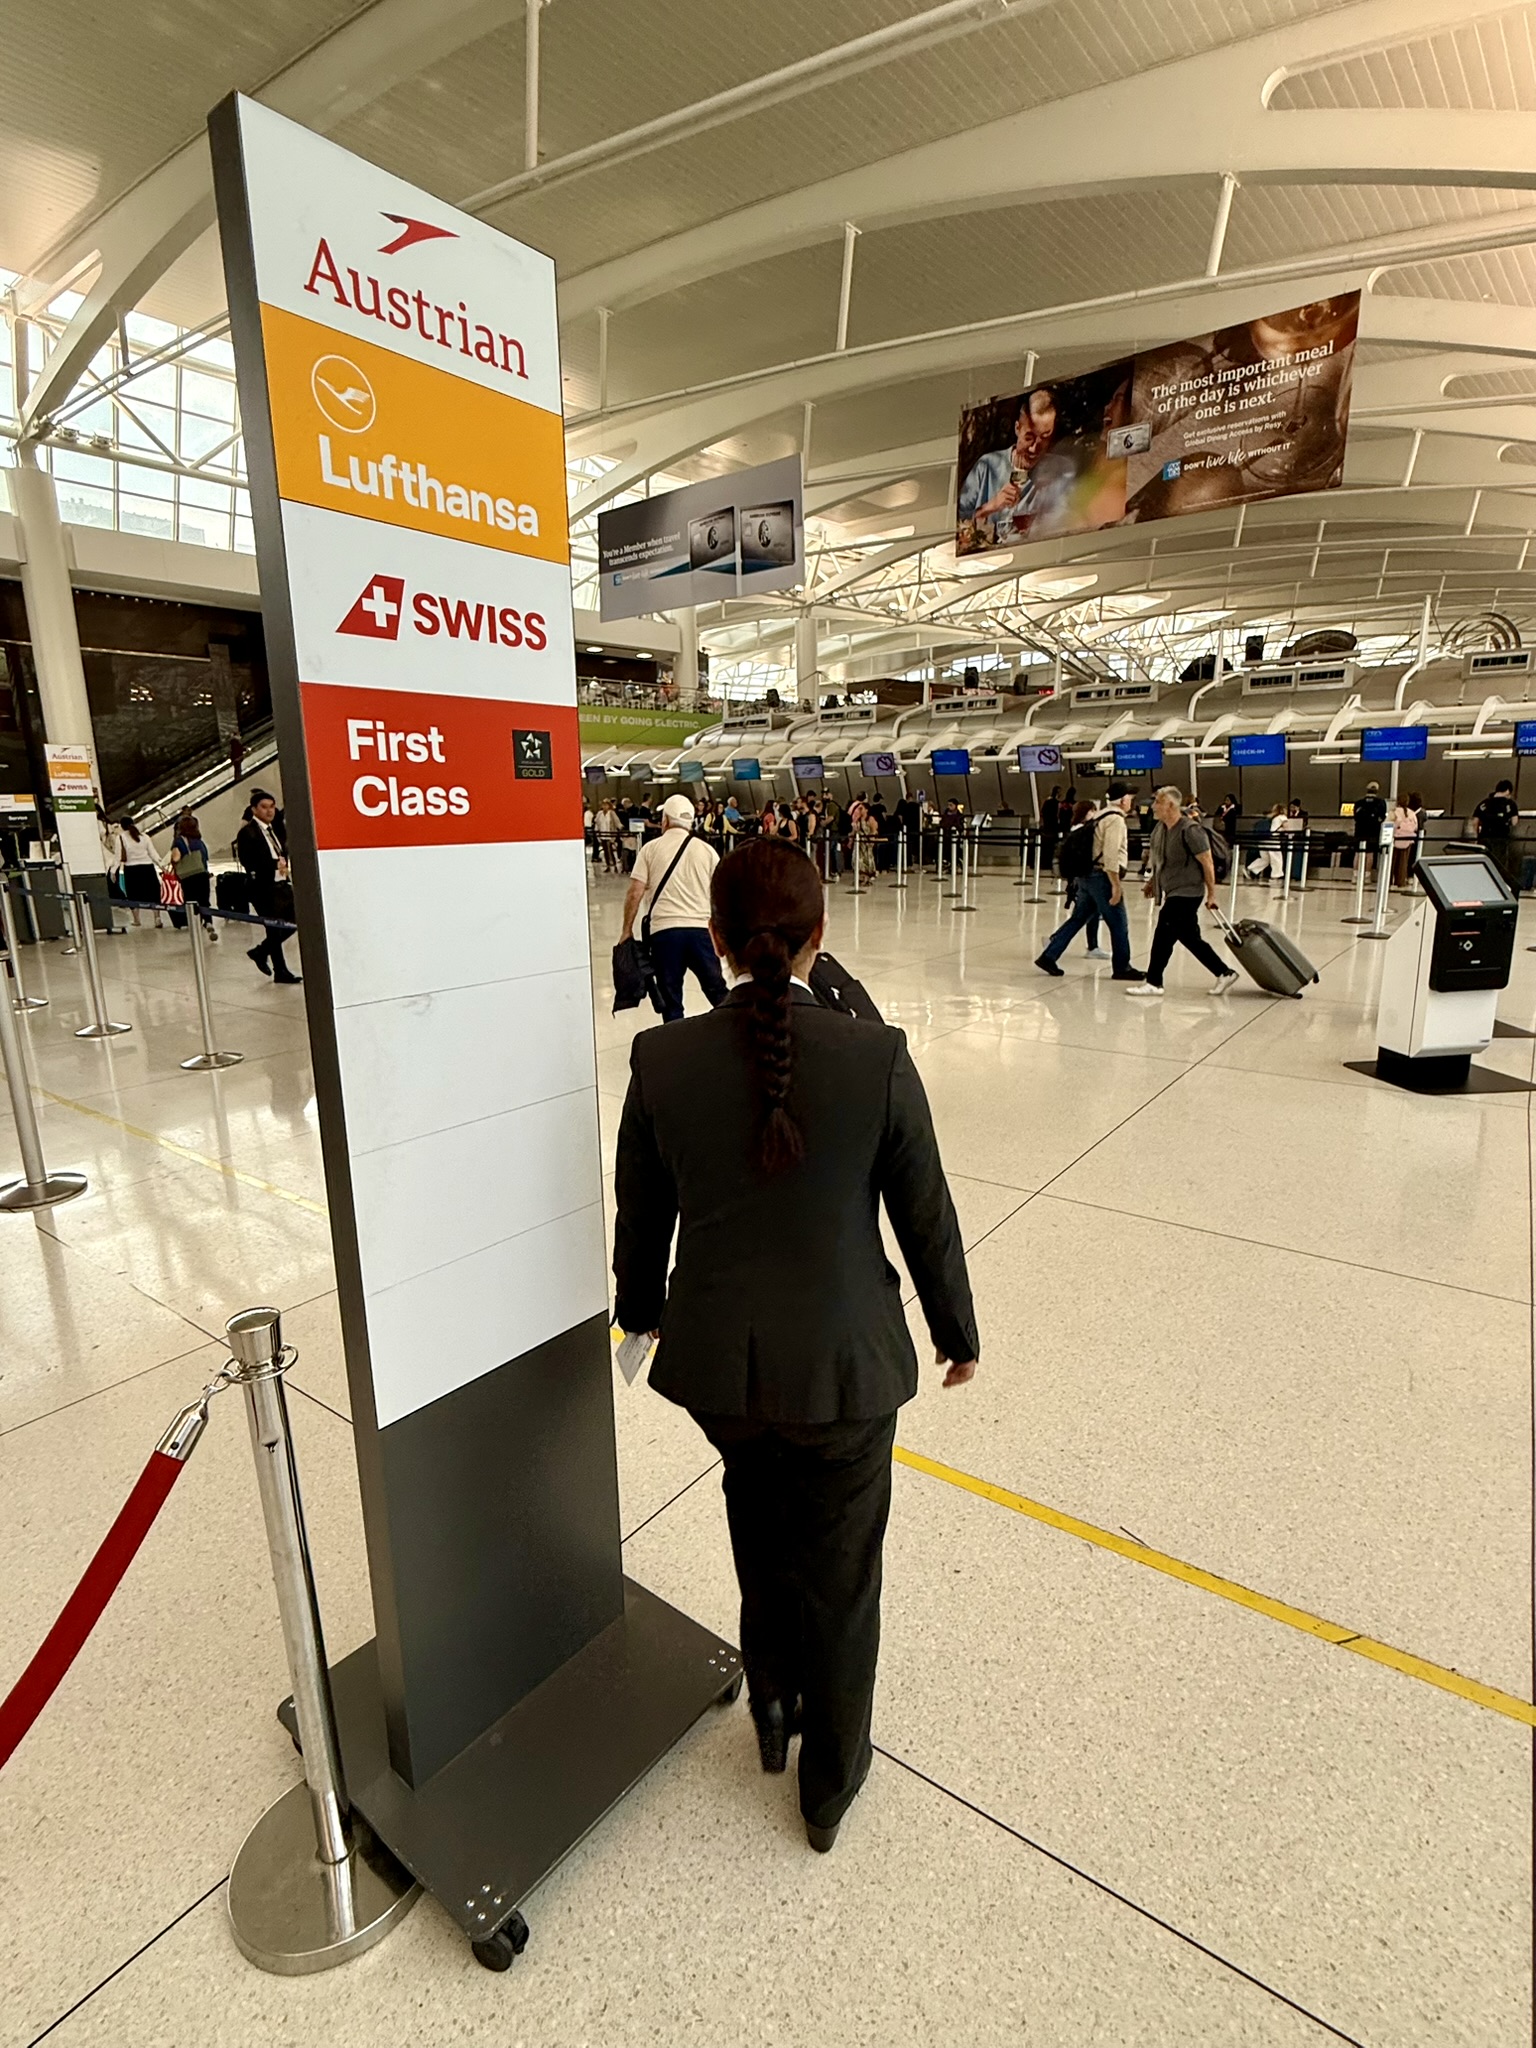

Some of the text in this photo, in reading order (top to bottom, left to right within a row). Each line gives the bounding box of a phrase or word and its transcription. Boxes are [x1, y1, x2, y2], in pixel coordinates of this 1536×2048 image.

[303, 237, 529, 379] Austrian
[1151, 340, 1334, 400] The most important meal
[1158, 362, 1323, 413] of the day is whichever
[1195, 391, 1276, 421] one is next.
[1183, 430, 1196, 440] Get
[1227, 415, 1270, 430] reservations
[1271, 410, 1287, 421] with
[1185, 436, 1206, 448] Global
[1207, 432, 1228, 445] Dining
[1229, 426, 1253, 438] Access
[1254, 424, 1263, 434] by
[1206, 455, 1227, 469] live
[1228, 448, 1246, 465] life
[1247, 444, 1281, 457] WITHOUT
[318, 433, 539, 537] Lufthansa
[624, 542, 646, 554] Member
[647, 537, 663, 548] when
[663, 532, 680, 544] travel
[609, 552, 638, 566] transcends
[412, 592, 547, 651] SWISS
[603, 715, 618, 724] BY
[620, 716, 653, 727] GOING
[346, 718, 446, 764] First
[52, 753, 83, 761] Austrian
[522, 769, 546, 778] GOLD
[352, 774, 470, 817] Class
